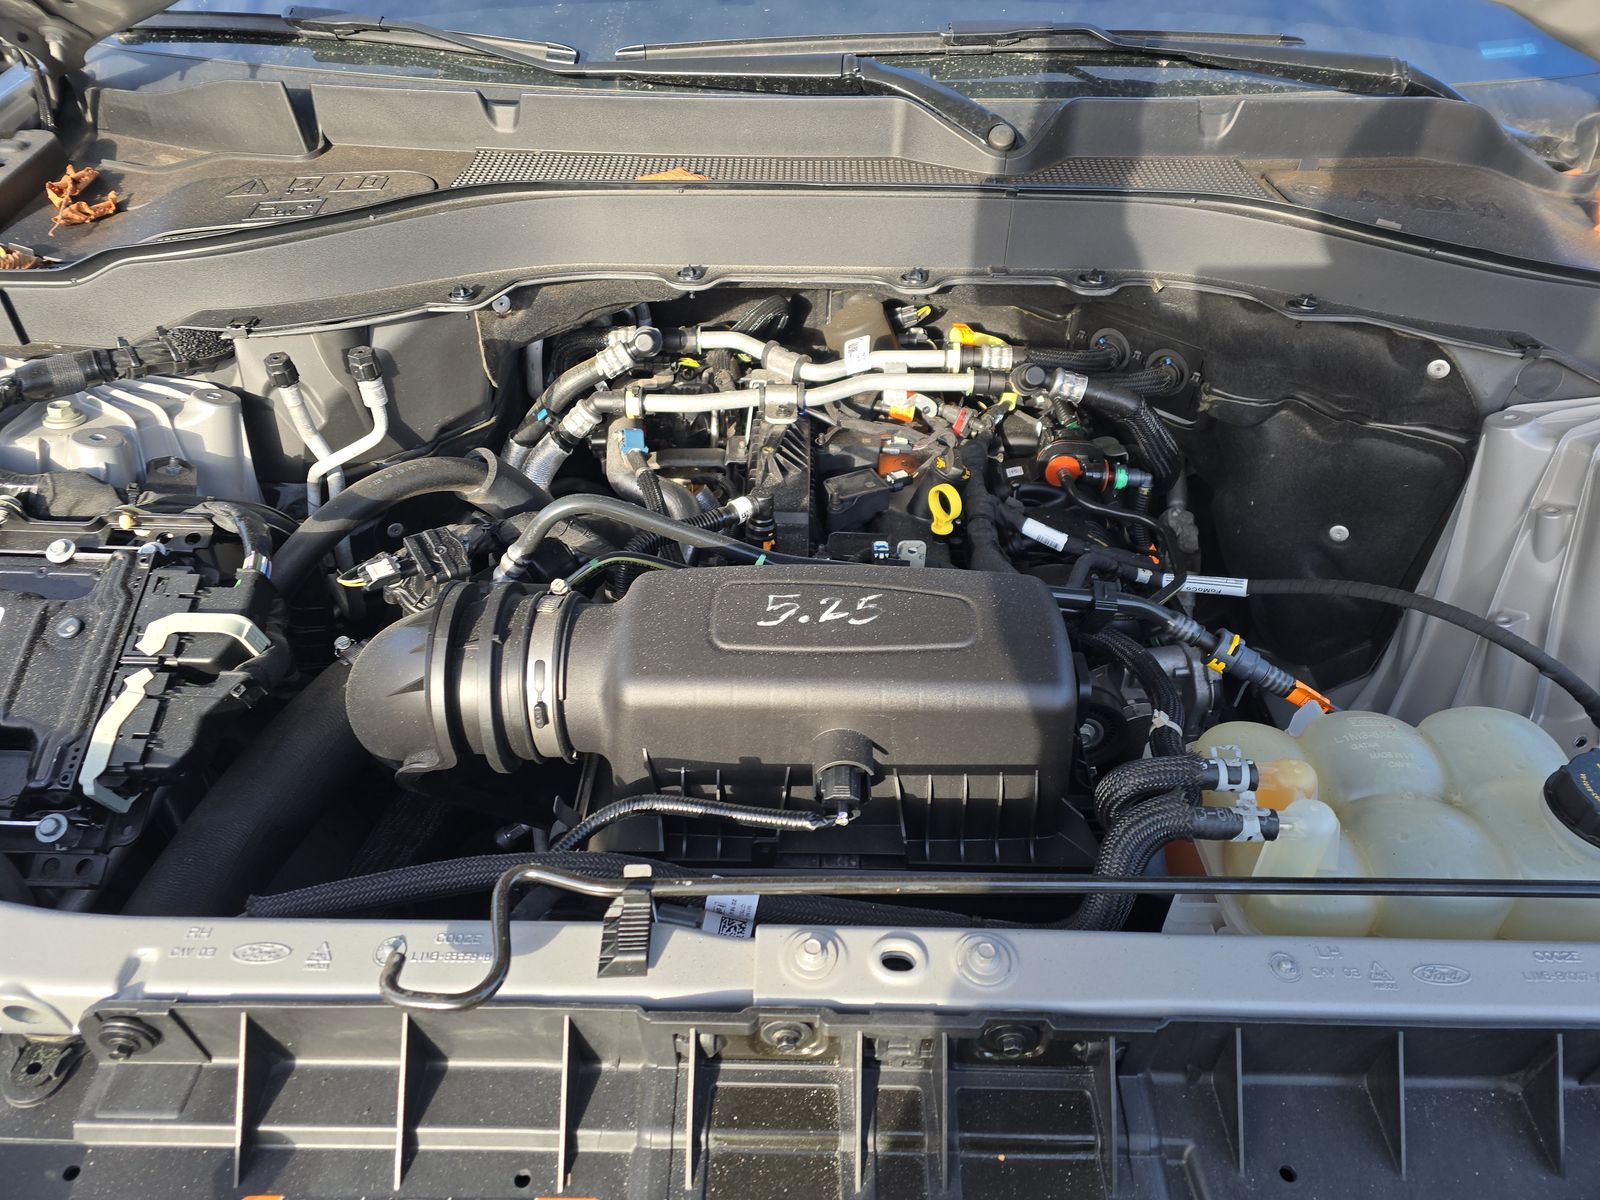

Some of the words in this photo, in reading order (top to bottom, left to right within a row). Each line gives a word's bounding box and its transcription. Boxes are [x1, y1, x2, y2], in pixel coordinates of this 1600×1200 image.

[757, 594, 885, 626] 5.25
[186, 926, 213, 939] RH
[1418, 966, 1466, 983] Ford
